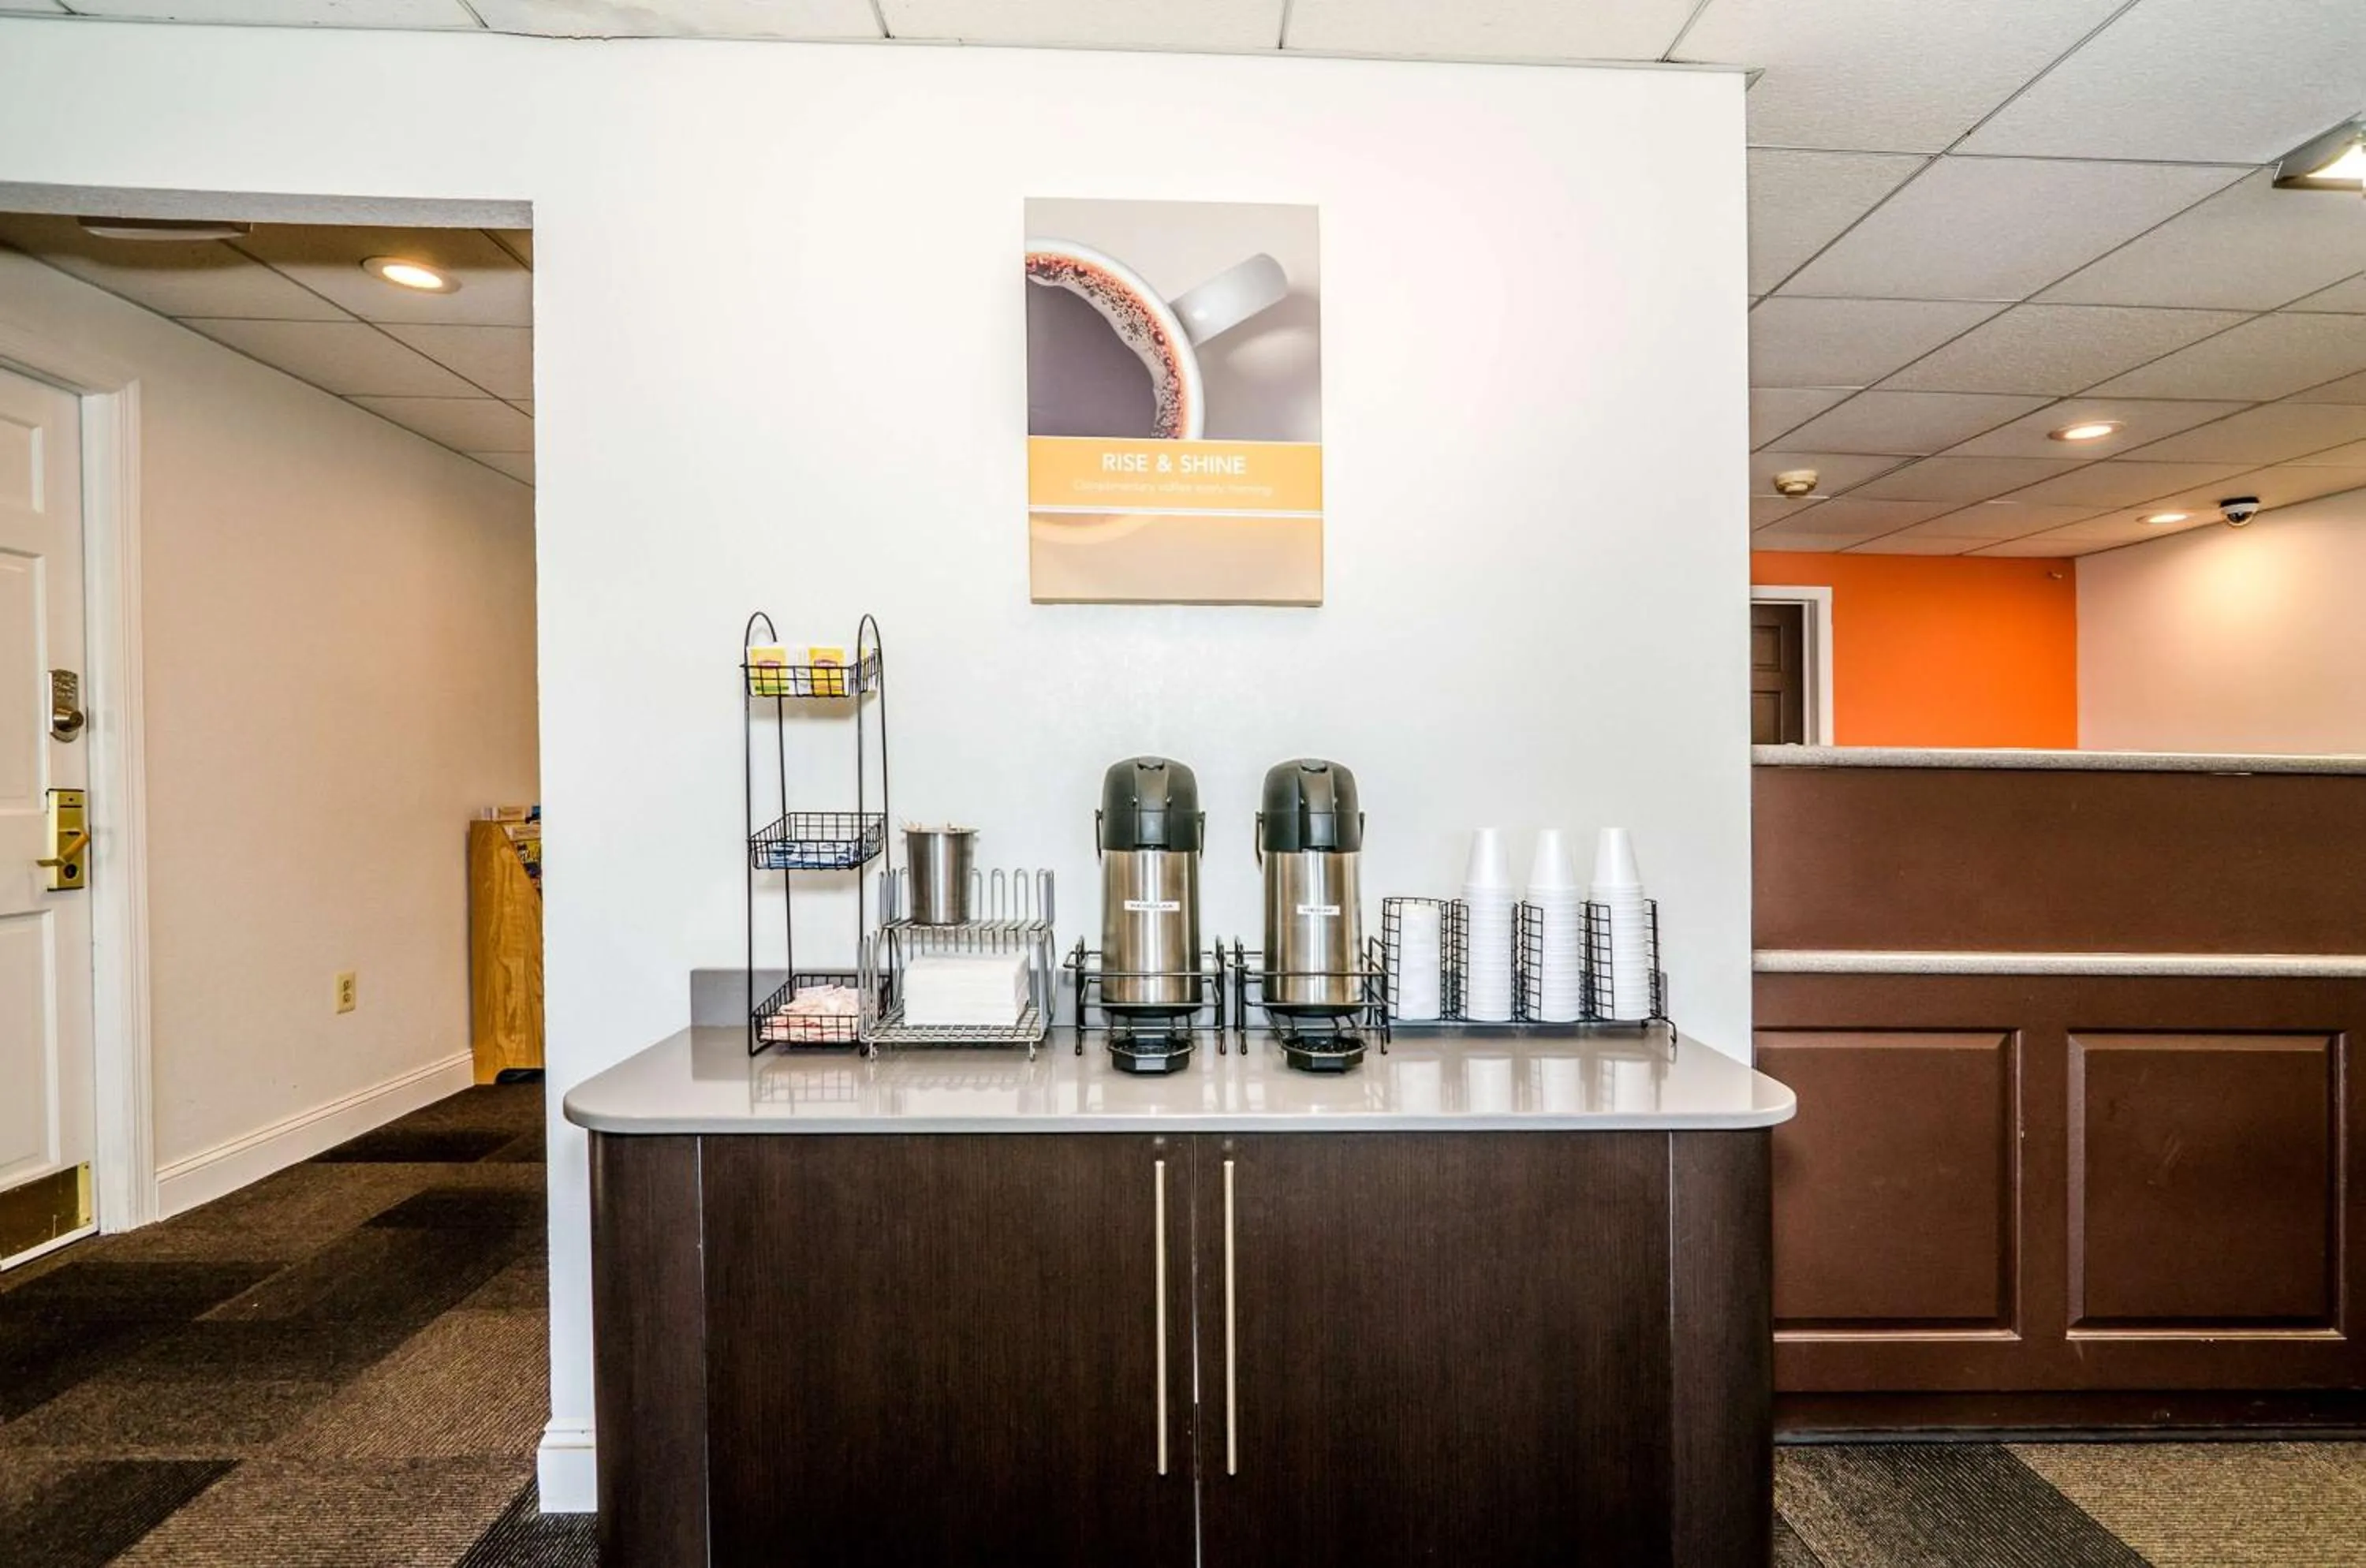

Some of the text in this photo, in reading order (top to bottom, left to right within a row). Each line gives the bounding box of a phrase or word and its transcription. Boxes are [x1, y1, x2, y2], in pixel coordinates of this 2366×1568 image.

[1101, 452, 1248, 475] RISE & SHINE
